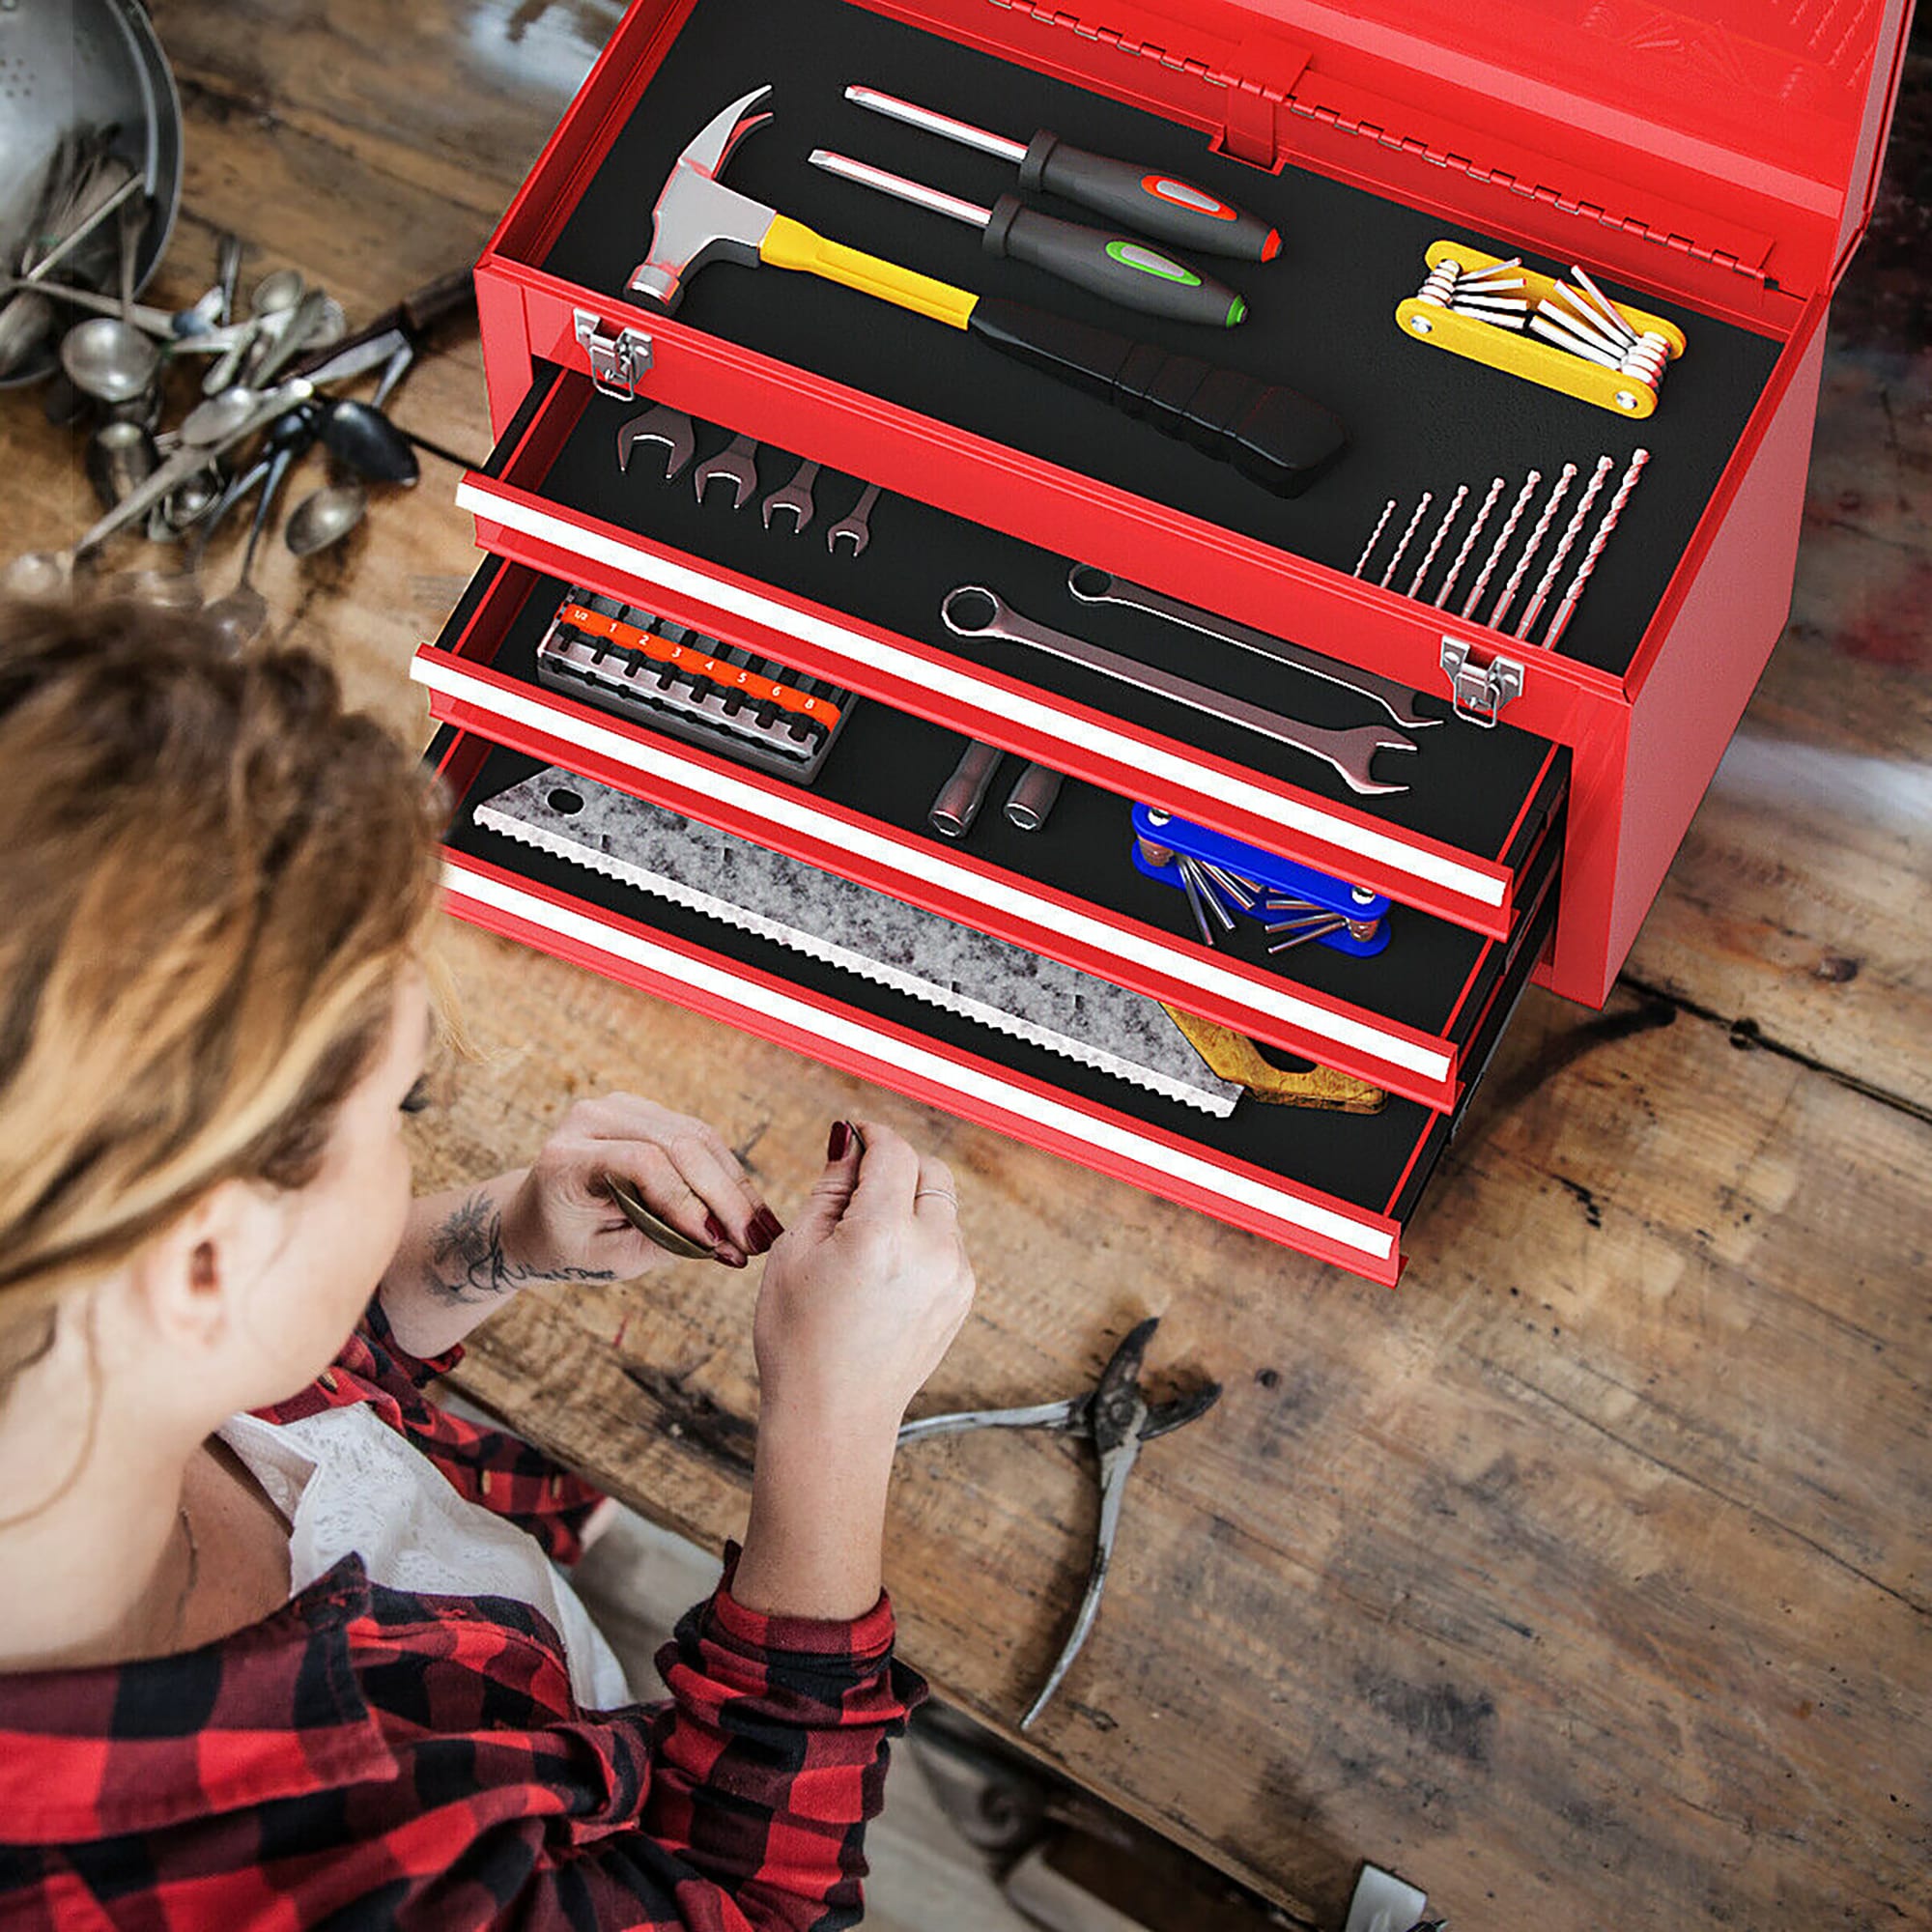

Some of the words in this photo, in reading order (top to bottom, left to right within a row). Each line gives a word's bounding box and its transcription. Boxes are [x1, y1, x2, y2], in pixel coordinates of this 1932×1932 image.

[610, 622, 617, 633] 1
[639, 635, 650, 645] 2
[671, 647, 682, 658] 3
[704, 661, 714, 670] 4
[737, 672, 748, 683] 5
[772, 686, 781, 696] 6
[805, 698, 815, 709] 8
